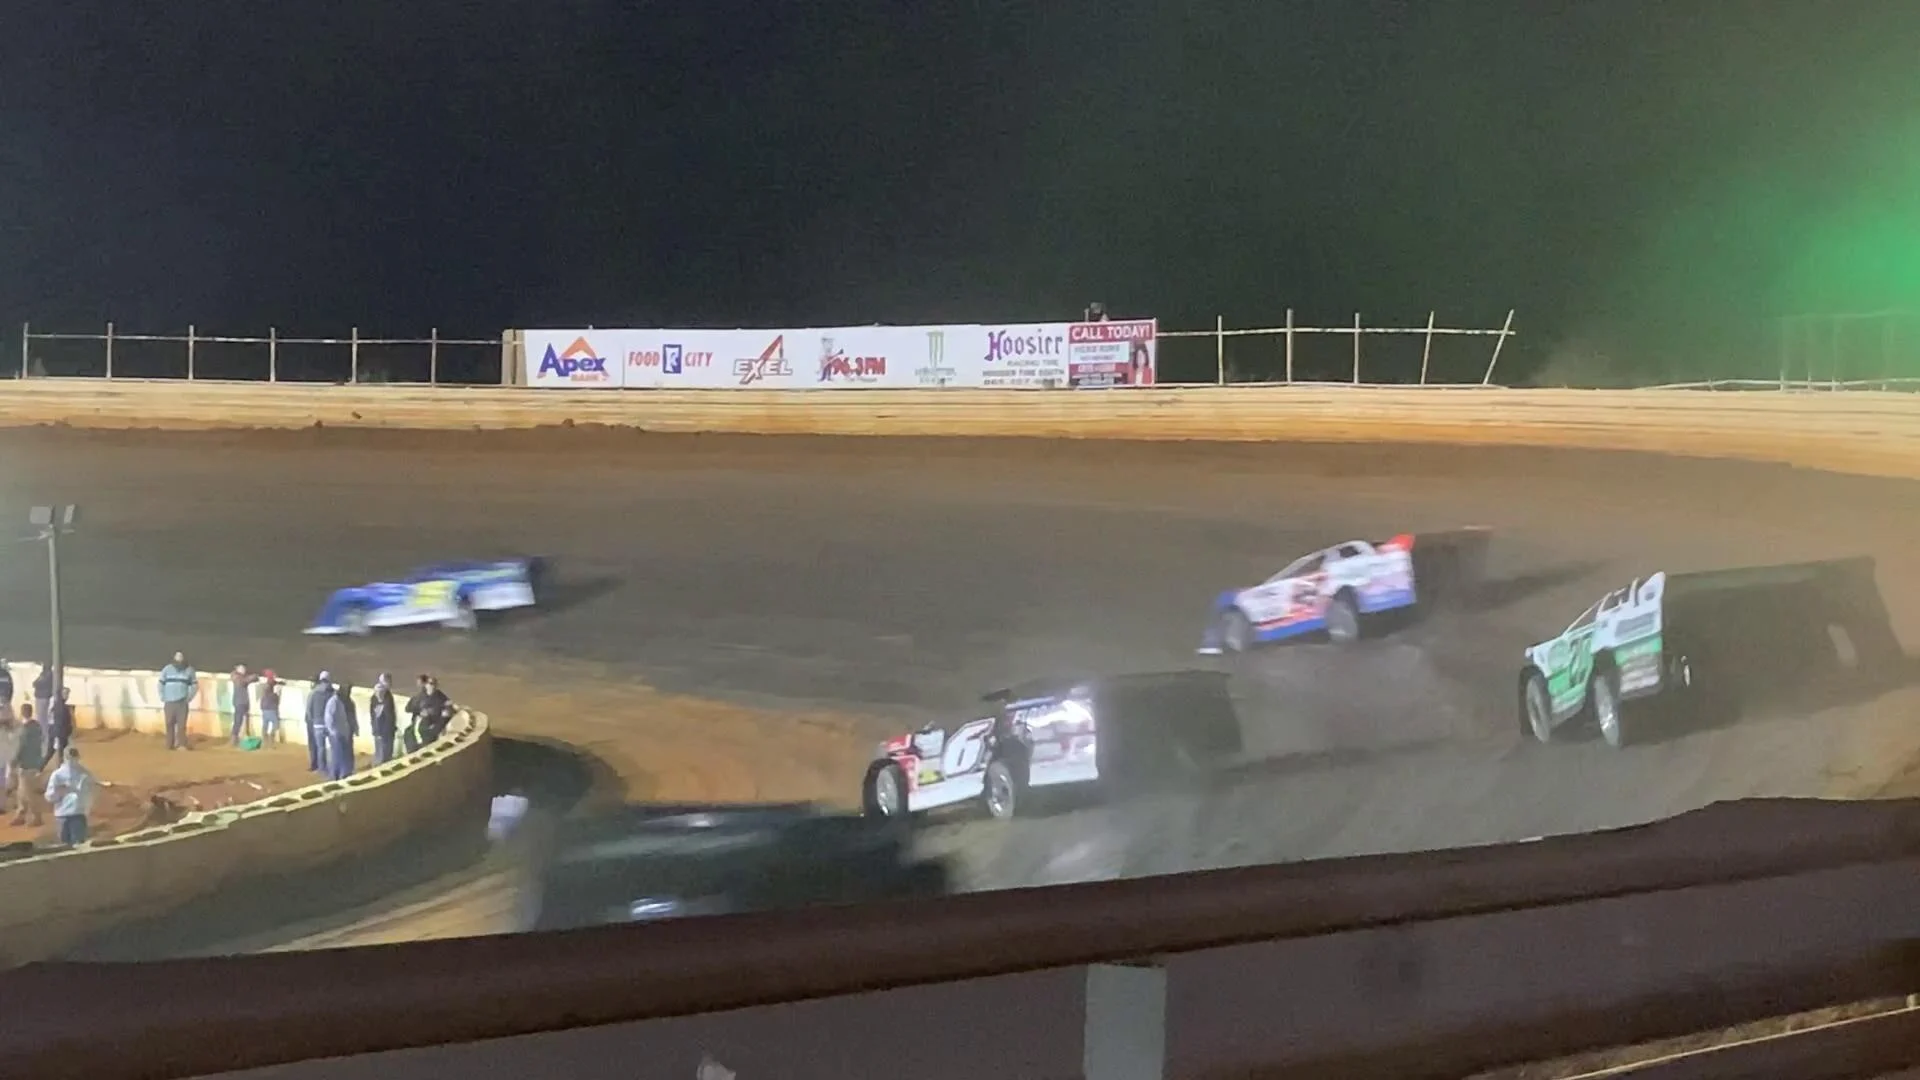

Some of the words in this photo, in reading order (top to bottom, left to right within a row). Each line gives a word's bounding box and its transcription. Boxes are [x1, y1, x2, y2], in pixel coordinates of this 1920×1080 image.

[984, 329, 1063, 361] Hoosier
[1071, 327, 1104, 340] CALL
[1106, 325, 1150, 338] TODAY!
[539, 342, 606, 377] Apex
[629, 351, 660, 367] FOOD
[685, 351, 713, 367] CITY
[944, 718, 995, 778] 6
